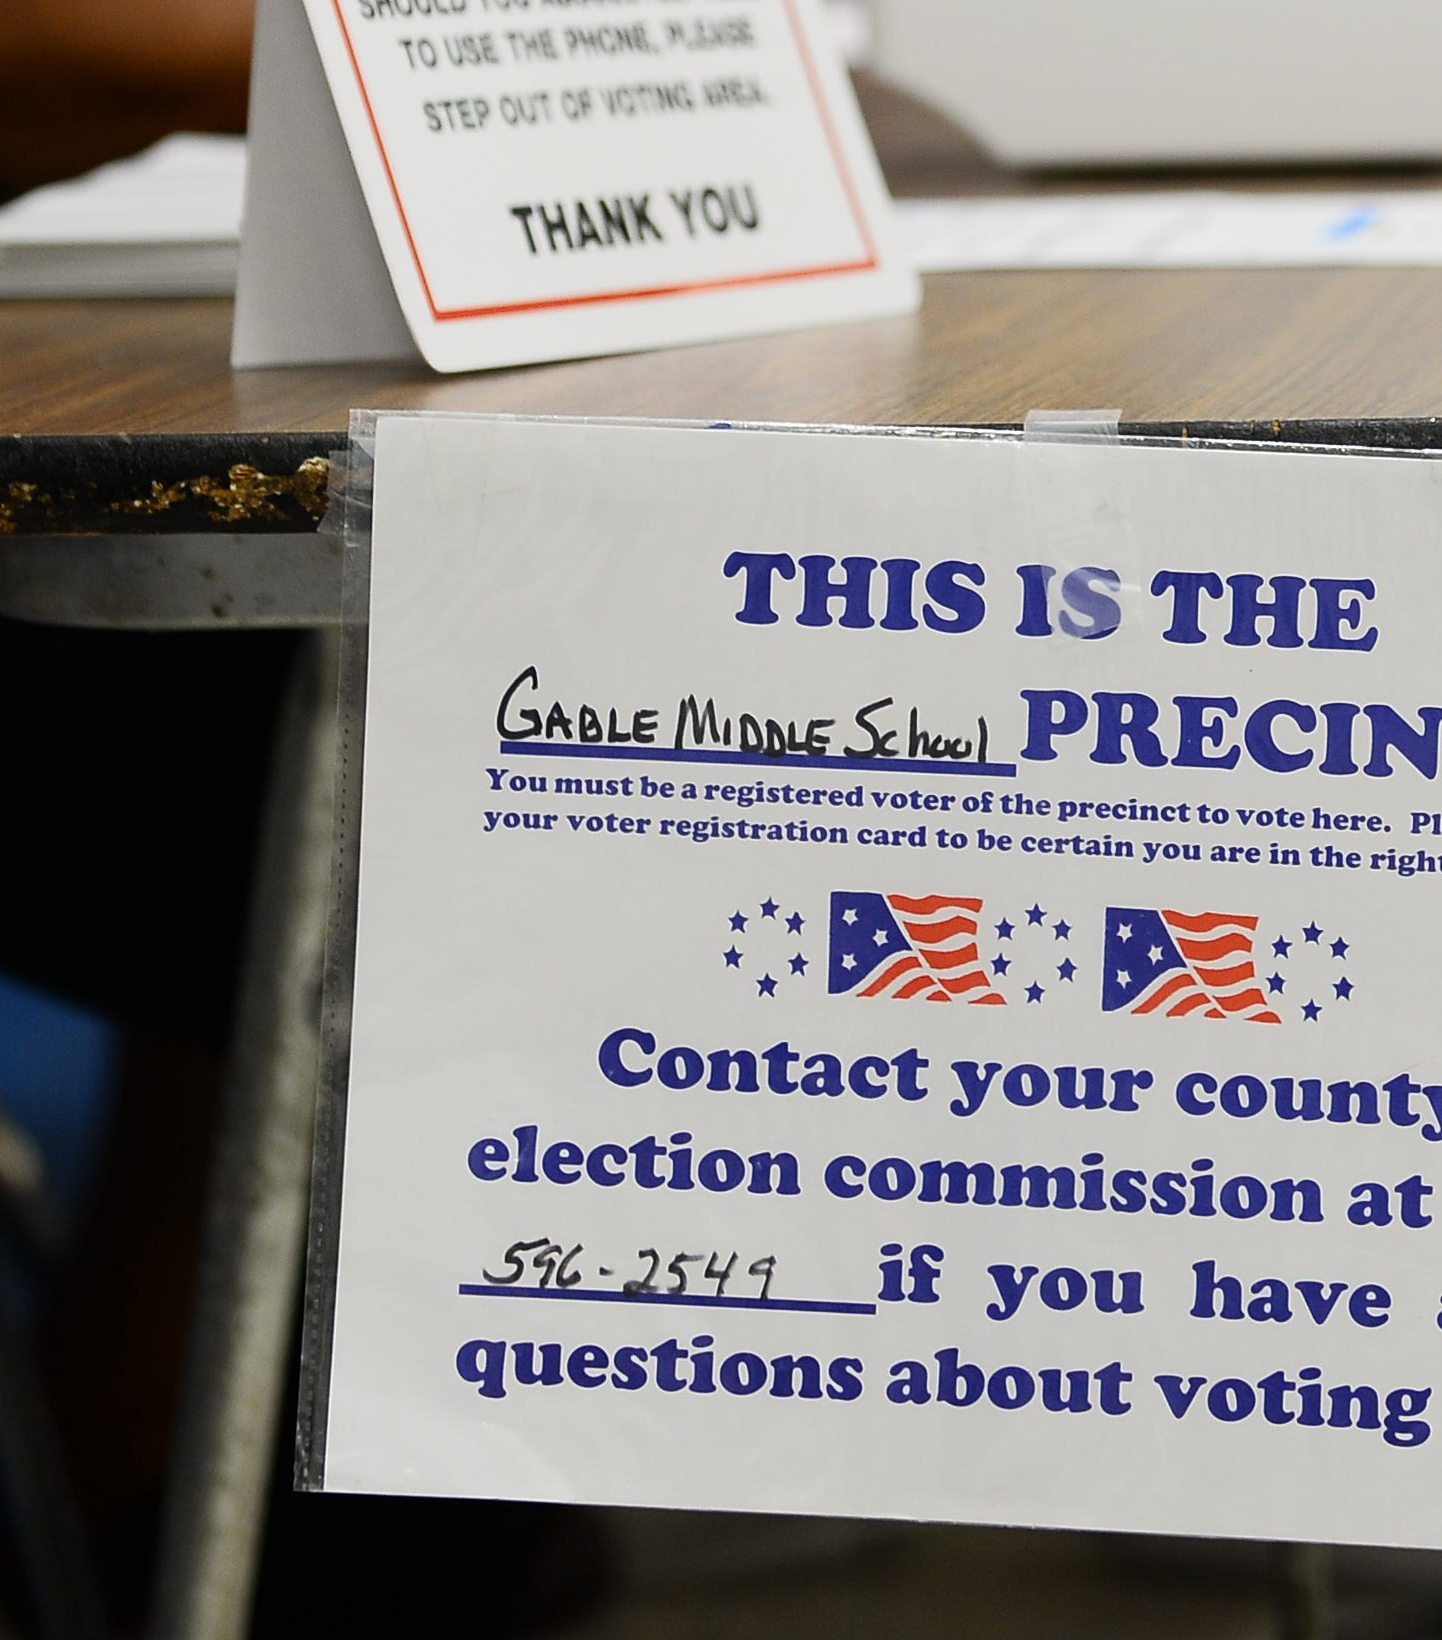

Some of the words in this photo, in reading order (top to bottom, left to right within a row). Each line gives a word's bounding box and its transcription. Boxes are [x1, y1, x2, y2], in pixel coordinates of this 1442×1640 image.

[398, 37, 438, 70] TO
[443, 32, 501, 68] USE
[503, 27, 560, 61] THE
[563, 22, 660, 56] PHONE,
[663, 16, 756, 51] PLEASE
[423, 97, 491, 133] STEP
[499, 90, 552, 128] OUT
[560, 87, 594, 122] OF
[599, 80, 696, 117] VOTING
[509, 194, 663, 254] THANK
[668, 185, 760, 238] YOU
[724, 552, 985, 633] THIS
[1016, 565, 1121, 639] IS
[1151, 570, 1378, 652] THE
[496, 665, 659, 742] GABLE
[673, 693, 836, 758] MIDDLE
[842, 696, 991, 765] School
[484, 812, 558, 832] your
[567, 814, 651, 834] voter
[660, 816, 848, 843] registration
[857, 826, 926, 847] card
[936, 829, 967, 849] to
[977, 829, 1012, 851] be
[1021, 835, 1134, 857] certain
[1143, 843, 1201, 863] you
[1211, 846, 1260, 863] are
[1270, 843, 1300, 865] in
[1310, 846, 1361, 868] the
[486, 769, 547, 792] You
[555, 777, 633, 796] must
[640, 776, 674, 798] be
[681, 784, 697, 799] a
[704, 781, 863, 807] registered
[871, 791, 956, 811] voter
[962, 792, 994, 813] of
[1000, 793, 1051, 815] the
[1058, 799, 1191, 822] precinct
[1197, 804, 1229, 824] to
[1236, 808, 1305, 828] vote
[1312, 808, 1391, 832] here.
[599, 1028, 929, 1101] Contact
[950, 1061, 1153, 1117] your
[468, 1125, 800, 1195] election
[825, 1153, 1324, 1222] commission
[1348, 1175, 1433, 1228] at
[878, 1244, 944, 1303] if
[987, 1265, 1144, 1321] you
[1190, 1260, 1391, 1327] have
[456, 1335, 863, 1401] questions
[887, 1348, 1132, 1415] about
[1154, 1368, 1431, 1447] voting
